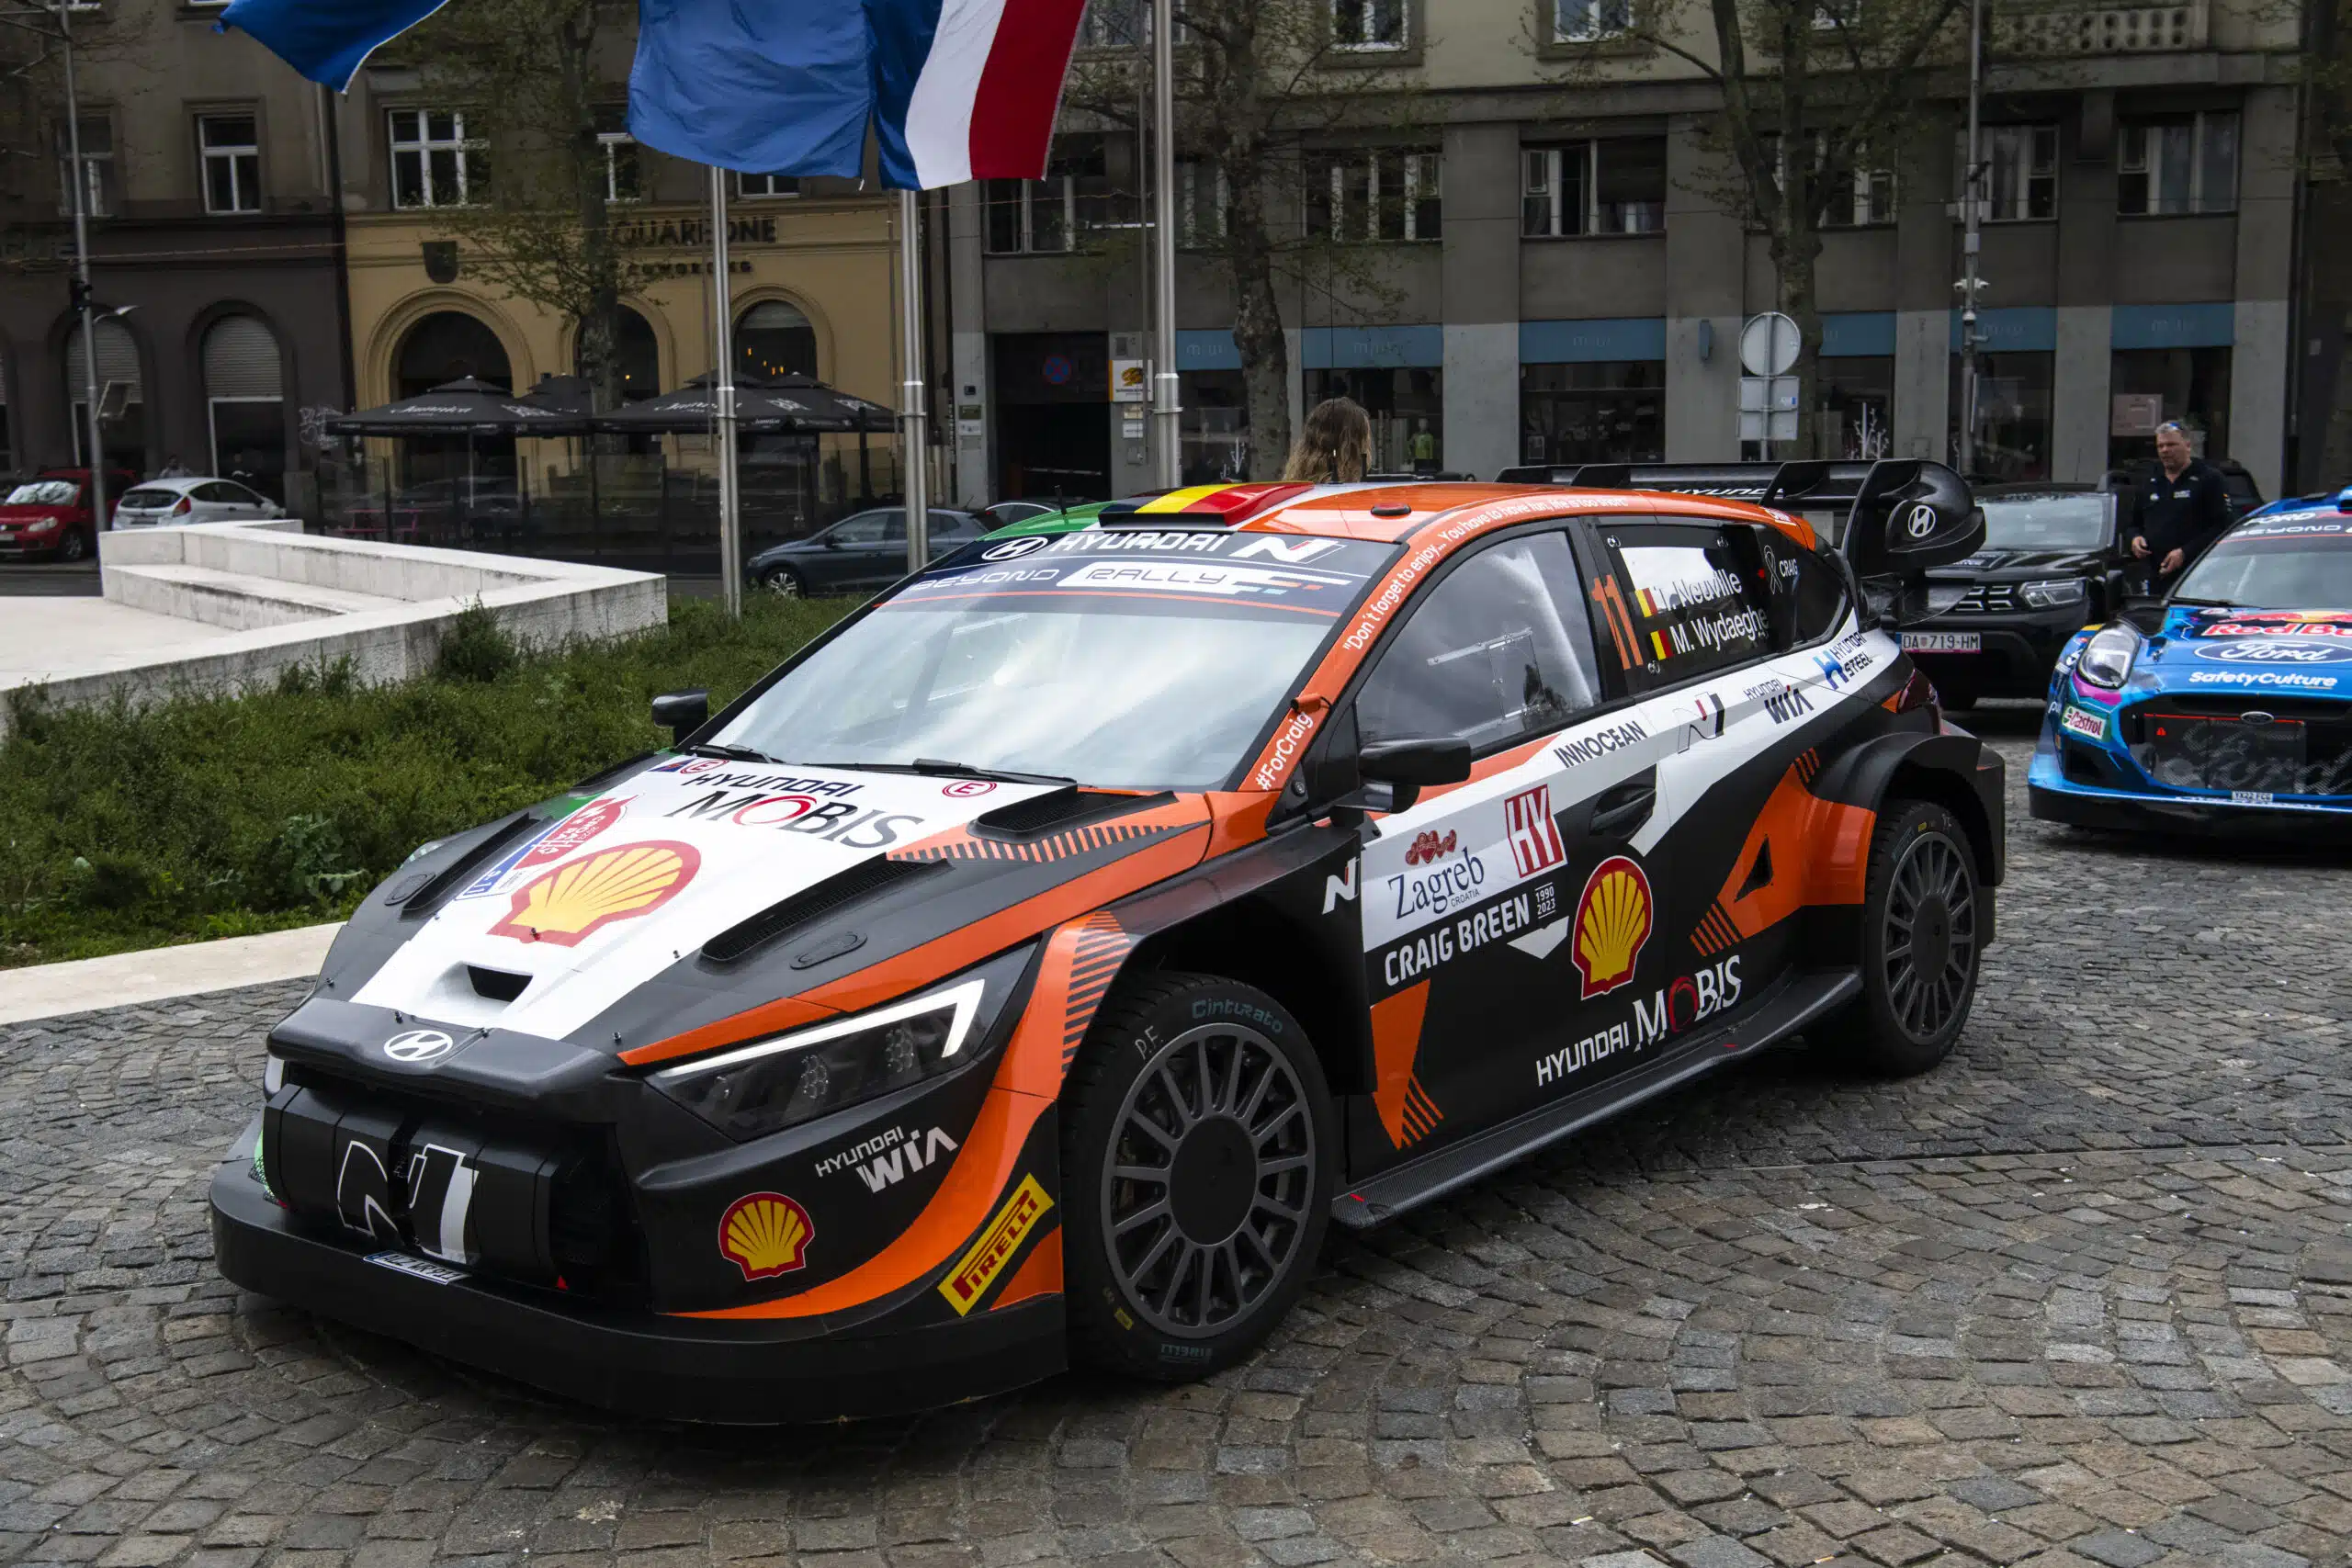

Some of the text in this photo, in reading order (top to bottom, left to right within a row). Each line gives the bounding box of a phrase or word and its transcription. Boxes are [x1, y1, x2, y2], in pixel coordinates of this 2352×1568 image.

[2244, 513, 2316, 525] FORD
[1049, 532, 1231, 552] HYUNDAI
[1370, 578, 1407, 616] forget
[1397, 568, 1416, 583] to
[1438, 524, 1466, 543] You
[1463, 513, 1492, 531] have
[1487, 508, 1503, 521] to
[1779, 558, 1799, 578] CRAIG
[911, 568, 1228, 591] BEYOND RALLY
[1672, 569, 1743, 608] Neuville
[1591, 573, 1644, 670] 11
[1669, 605, 1770, 655] M. Wydaeghe
[2201, 623, 2300, 637] Red
[1830, 631, 1868, 660] HYUNDAI
[2220, 643, 2335, 662] Ford
[1845, 650, 1874, 678] STEEL
[1743, 678, 1785, 701] HYUNDAI
[2072, 711, 2103, 736] Castrol
[1255, 712, 1314, 791] #ForCraig
[1553, 719, 1648, 769] INNOCEAN
[681, 773, 865, 797] HYUNDAI
[662, 791, 925, 849] MOBIS
[1387, 845, 1485, 920] Zagreb
[1535, 885, 1555, 904] 1990
[1451, 888, 1480, 908] CROATIA
[1536, 897, 1556, 916] 2023
[1385, 892, 1530, 987] CRAIG BREEN
[1192, 999, 1283, 1033] Cinturato
[1535, 954, 1742, 1087] HYUNDAI MOBIS
[815, 1125, 905, 1179] HYUNDAI
[952, 1189, 1038, 1302] PIRELLI
